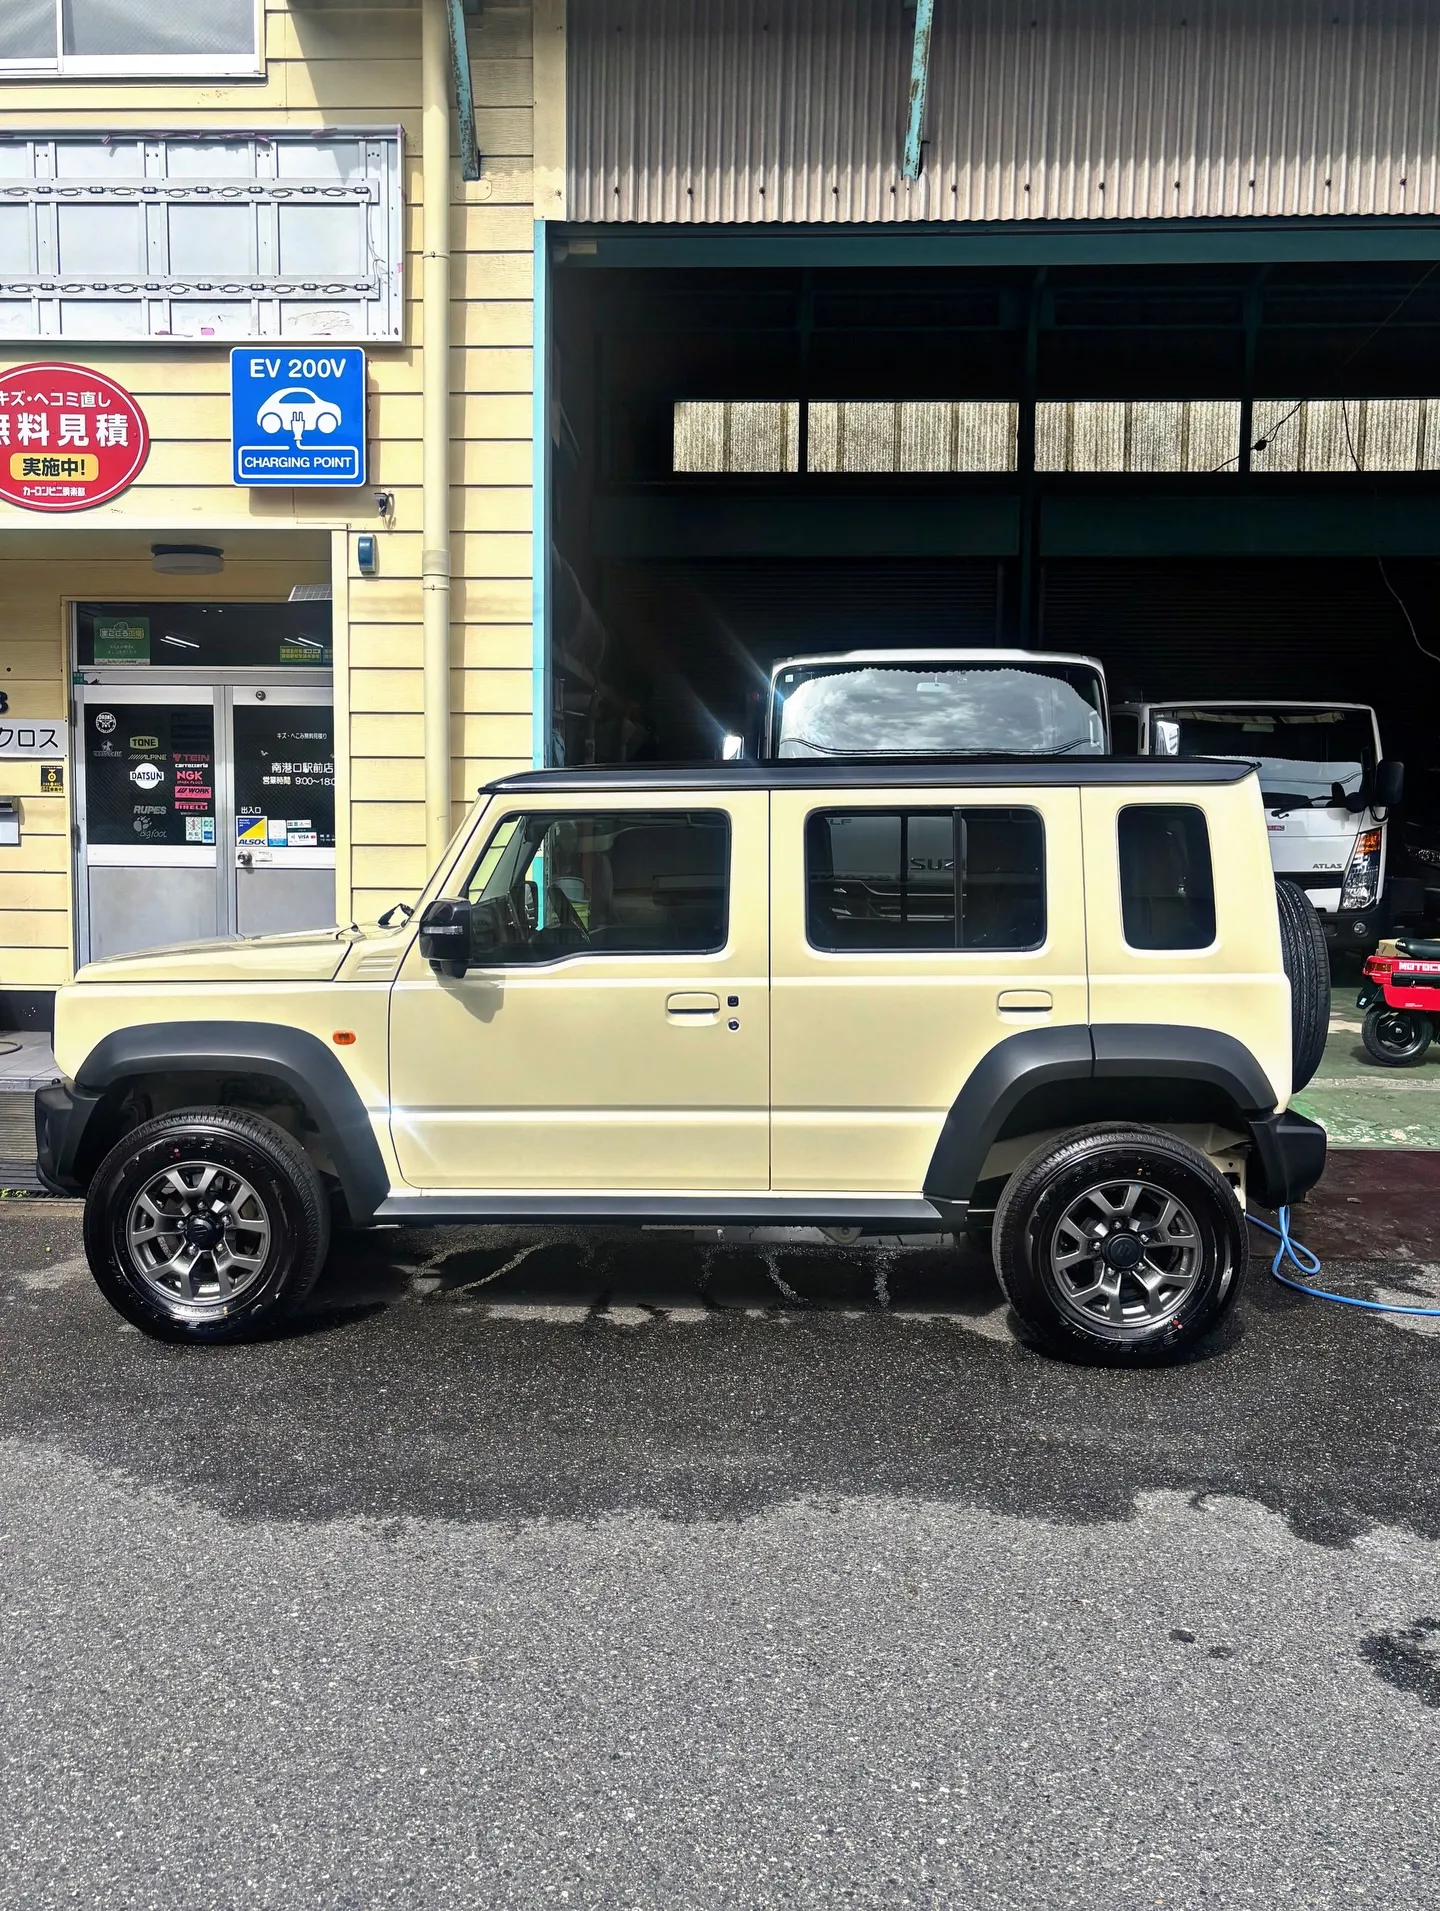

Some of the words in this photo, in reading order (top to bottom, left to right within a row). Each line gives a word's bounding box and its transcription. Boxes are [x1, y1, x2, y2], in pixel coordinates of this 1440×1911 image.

[250, 358, 281, 378] EV
[288, 358, 346, 378] 200V
[244, 456, 310, 468] CHARGING
[313, 457, 352, 468] POINT
[22, 457, 85, 477] 実施中!
[132, 738, 156, 747] TONE
[271, 763, 334, 773] 南港口駅前店
[131, 772, 163, 780] DATSUN
[177, 771, 203, 780] NGK
[263, 776, 291, 785] 営業時間
[134, 805, 167, 814] RUPES
[241, 806, 261, 814] 出入口
